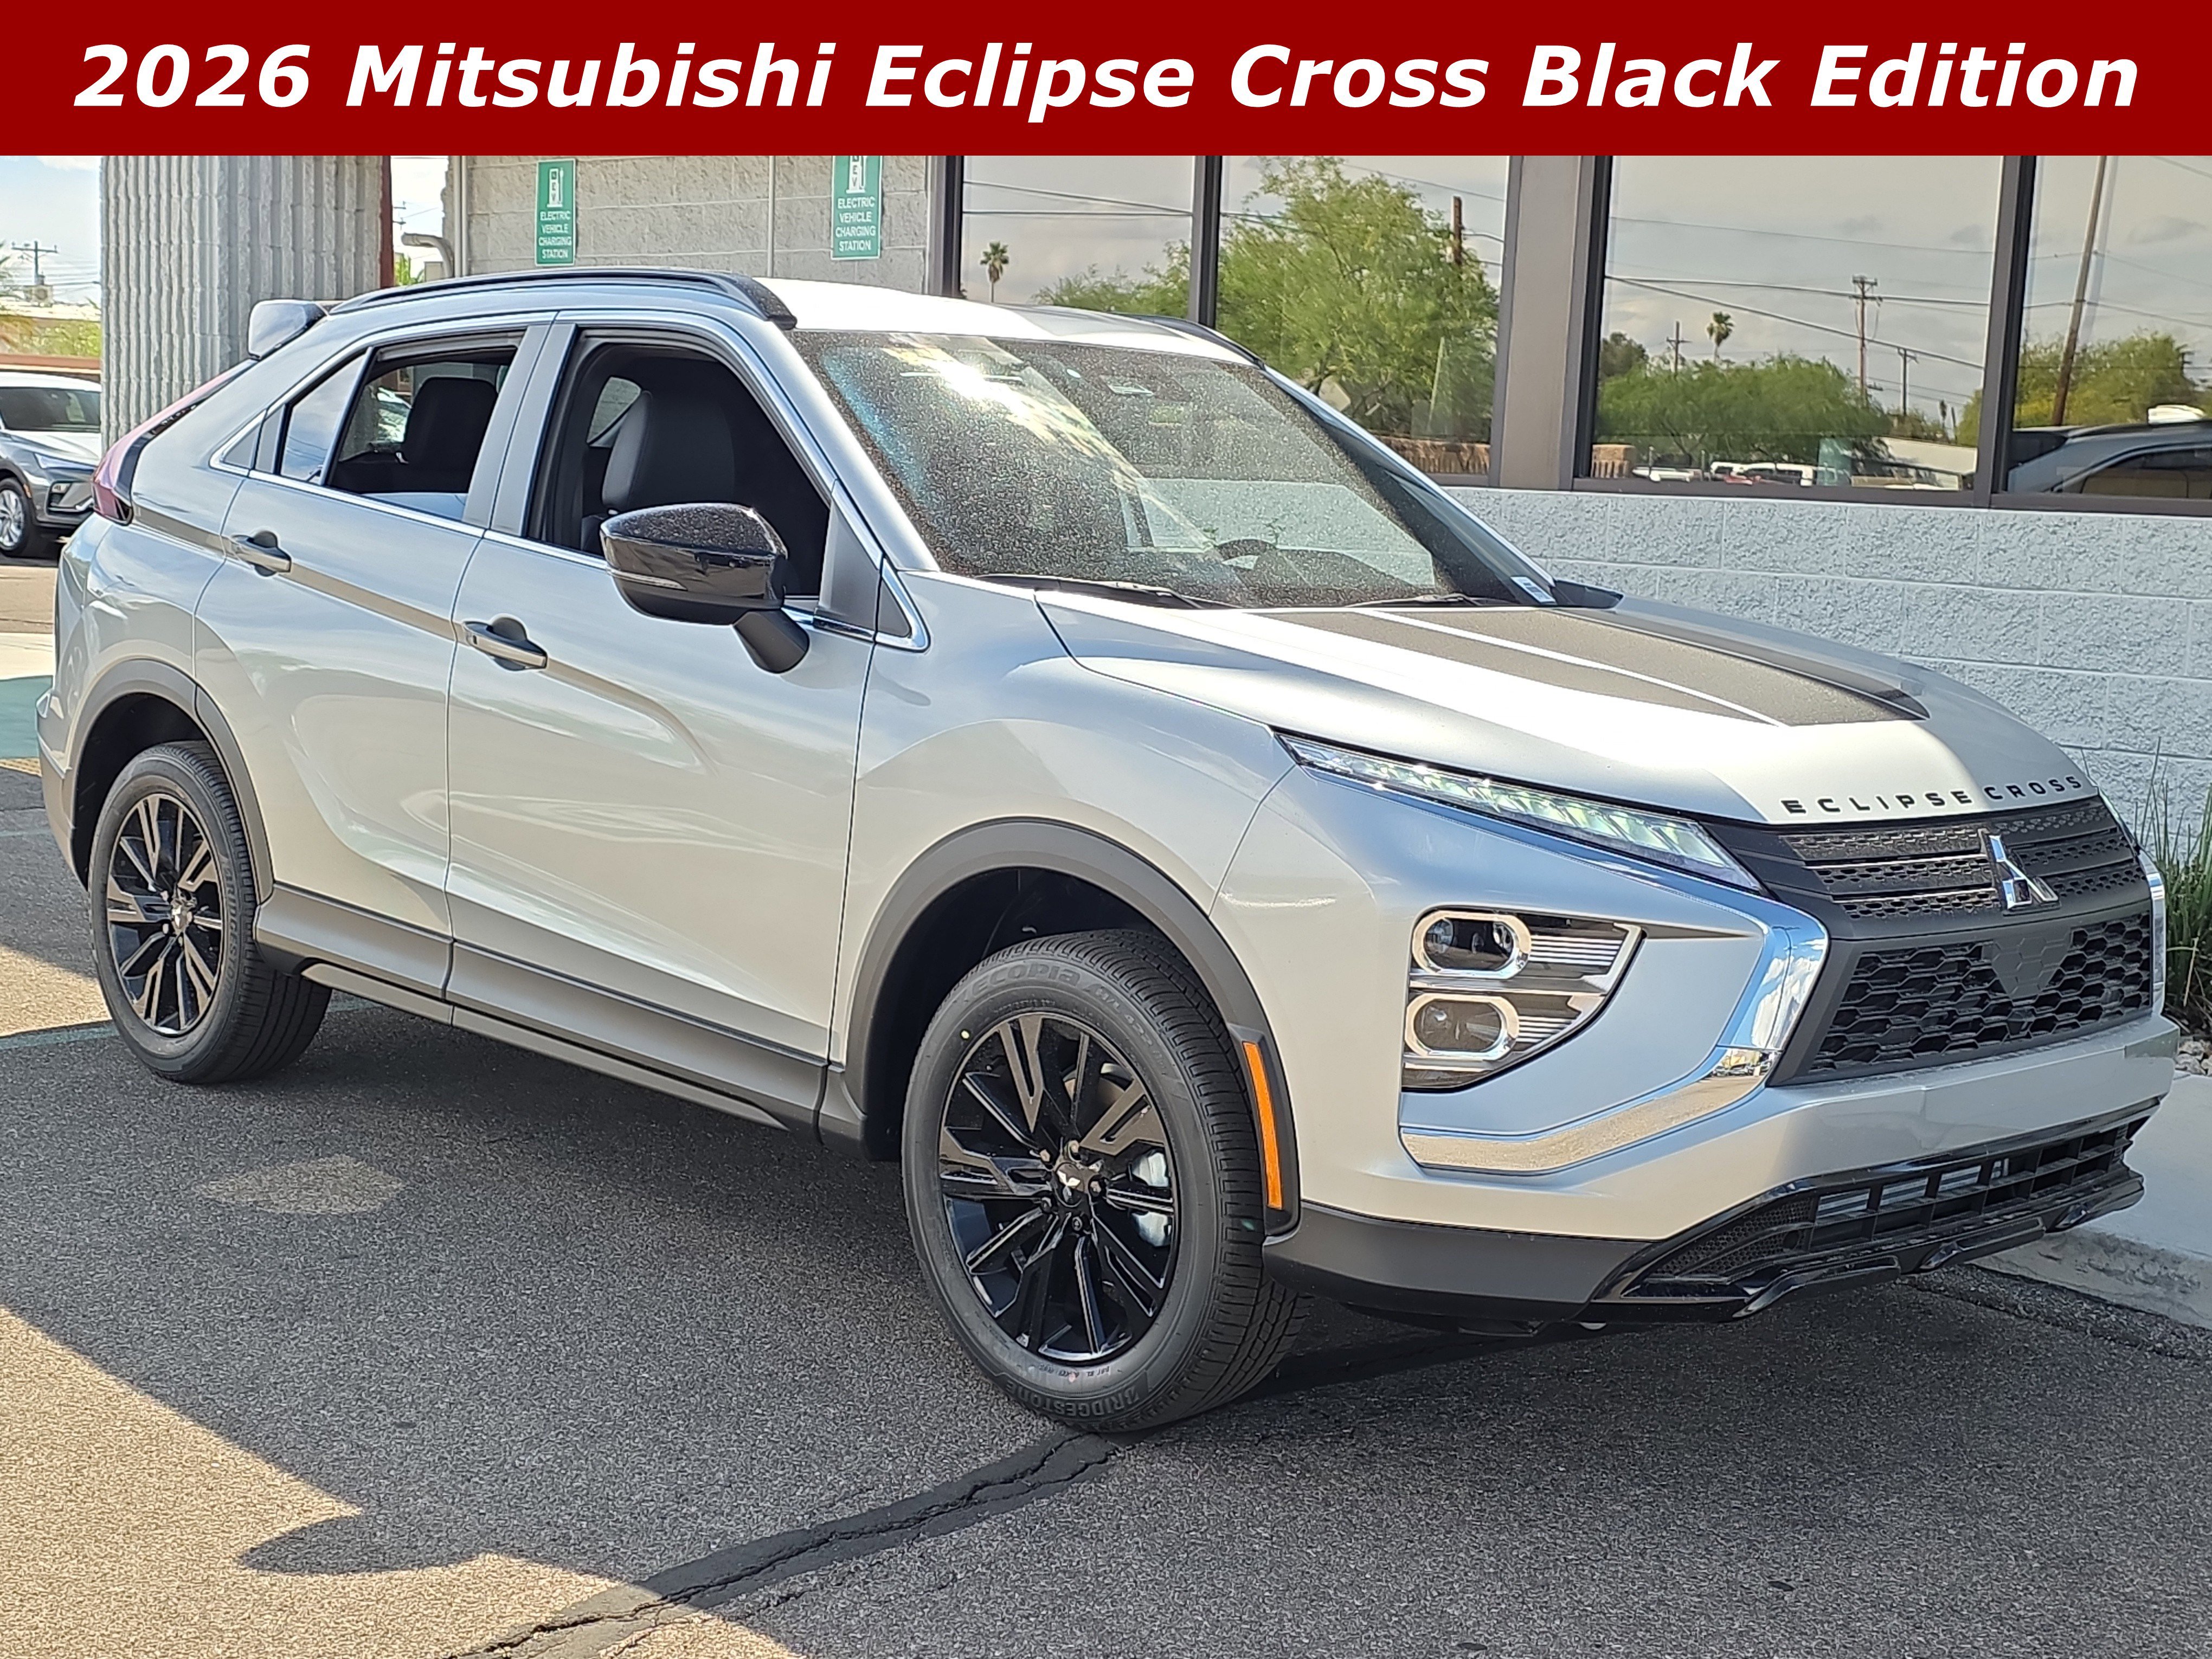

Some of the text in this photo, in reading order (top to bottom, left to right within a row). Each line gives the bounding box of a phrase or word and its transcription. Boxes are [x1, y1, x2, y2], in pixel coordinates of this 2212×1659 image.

[837, 196, 876, 209] ELECTRIC
[539, 210, 571, 221] ELECTRIC
[839, 211, 872, 223] VEHICLE
[541, 223, 569, 234] VEHICLE
[835, 226, 876, 237] CHARGING
[538, 236, 572, 246] CHARGING
[839, 240, 872, 252] STATION
[542, 249, 568, 259] STATION
[1780, 775, 2082, 813] ECLIPSE CROSS
[1005, 1380, 1139, 1417] BRIDGESTONE
